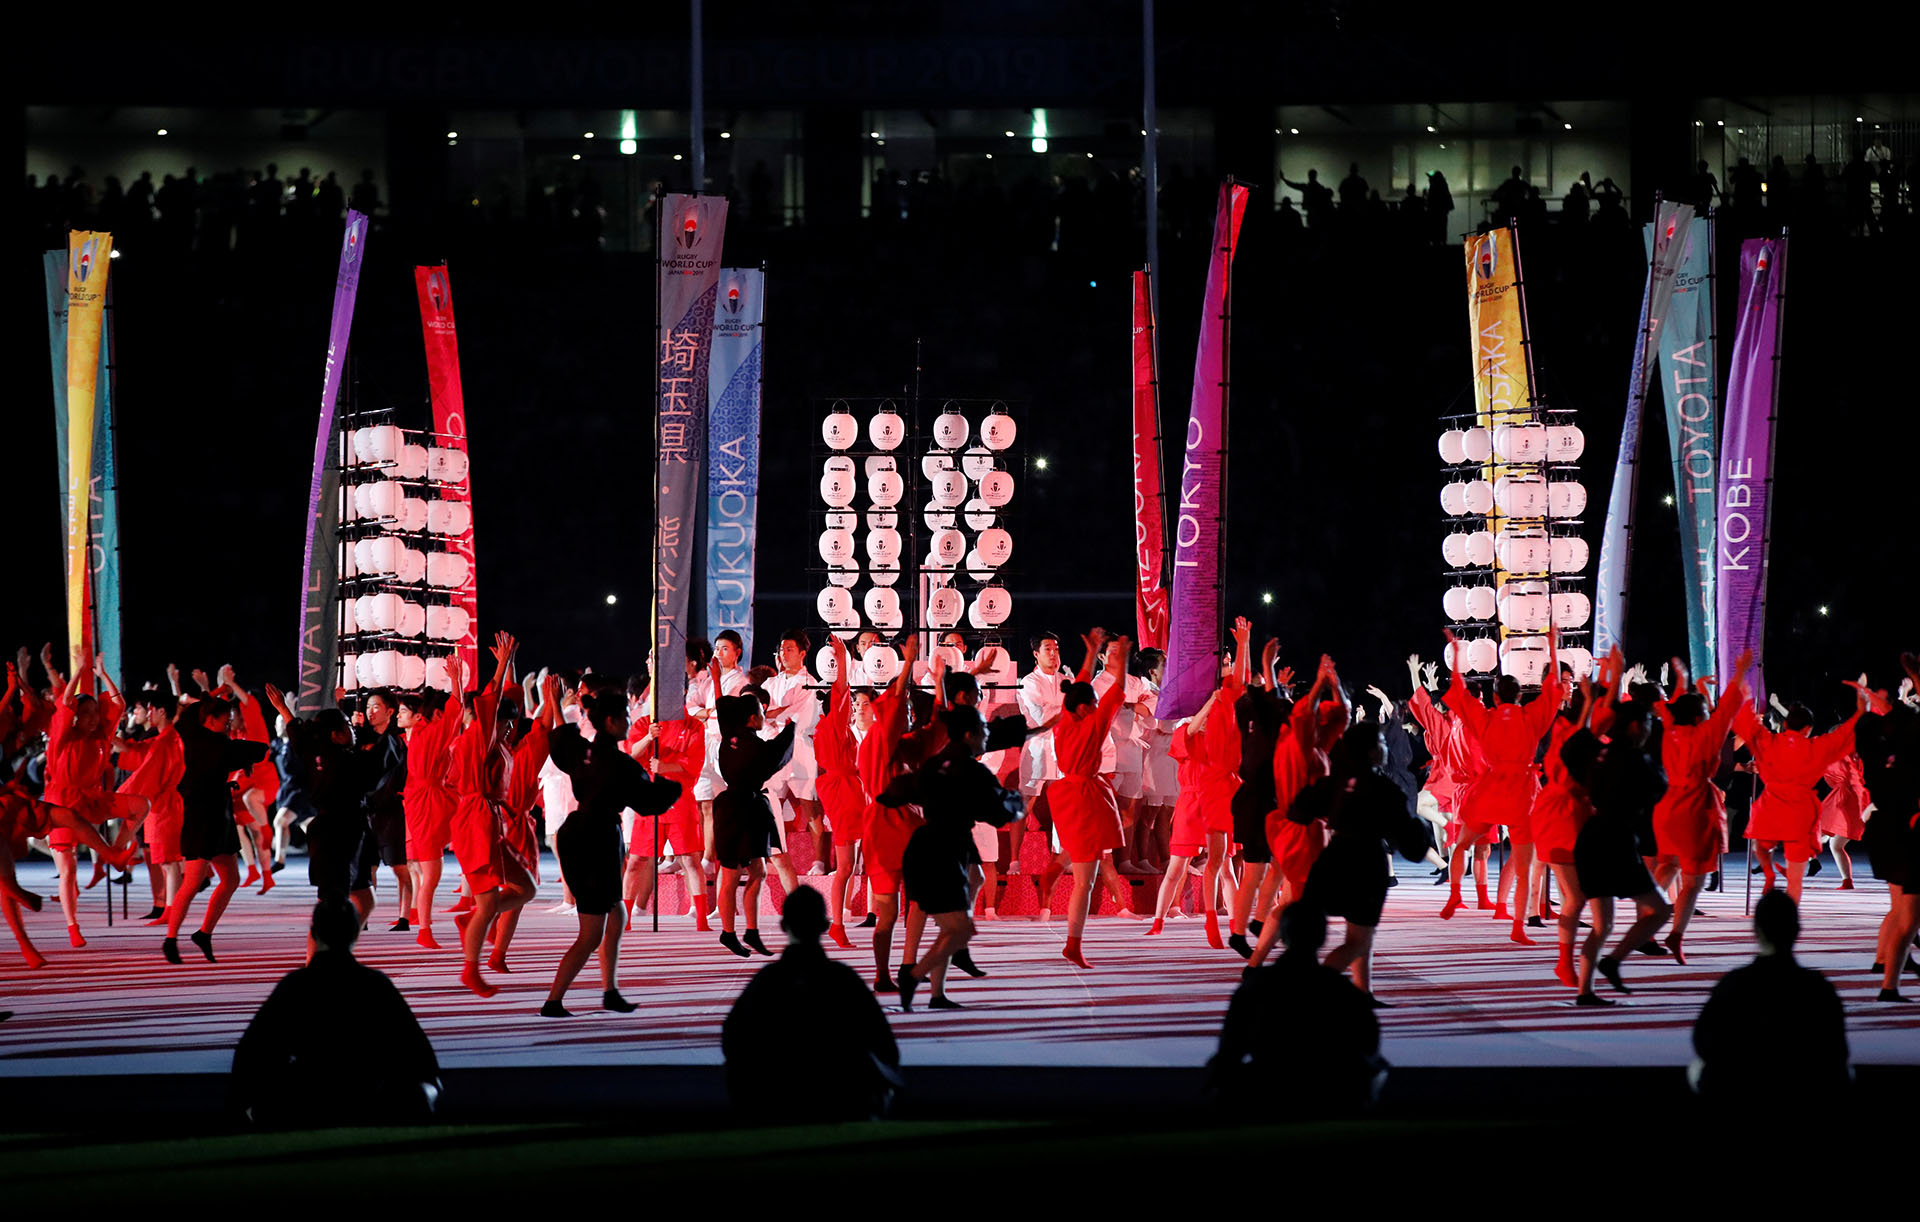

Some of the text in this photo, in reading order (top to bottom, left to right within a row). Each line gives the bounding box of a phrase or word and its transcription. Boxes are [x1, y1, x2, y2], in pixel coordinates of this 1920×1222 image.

[298, 46, 516, 91] RUGBY
[773, 46, 899, 91] CUP
[916, 46, 1046, 91] 2019
[662, 260, 713, 269] WORLD CUP
[1494, 285, 1510, 294] CUP
[740, 324, 756, 332] CUP
[1480, 320, 1513, 423] OSAKA
[1672, 340, 1712, 504] TOYOTA
[717, 434, 747, 629] FUKUOKA
[1174, 416, 1203, 577] TOKYO
[1722, 457, 1754, 571] KOBE
